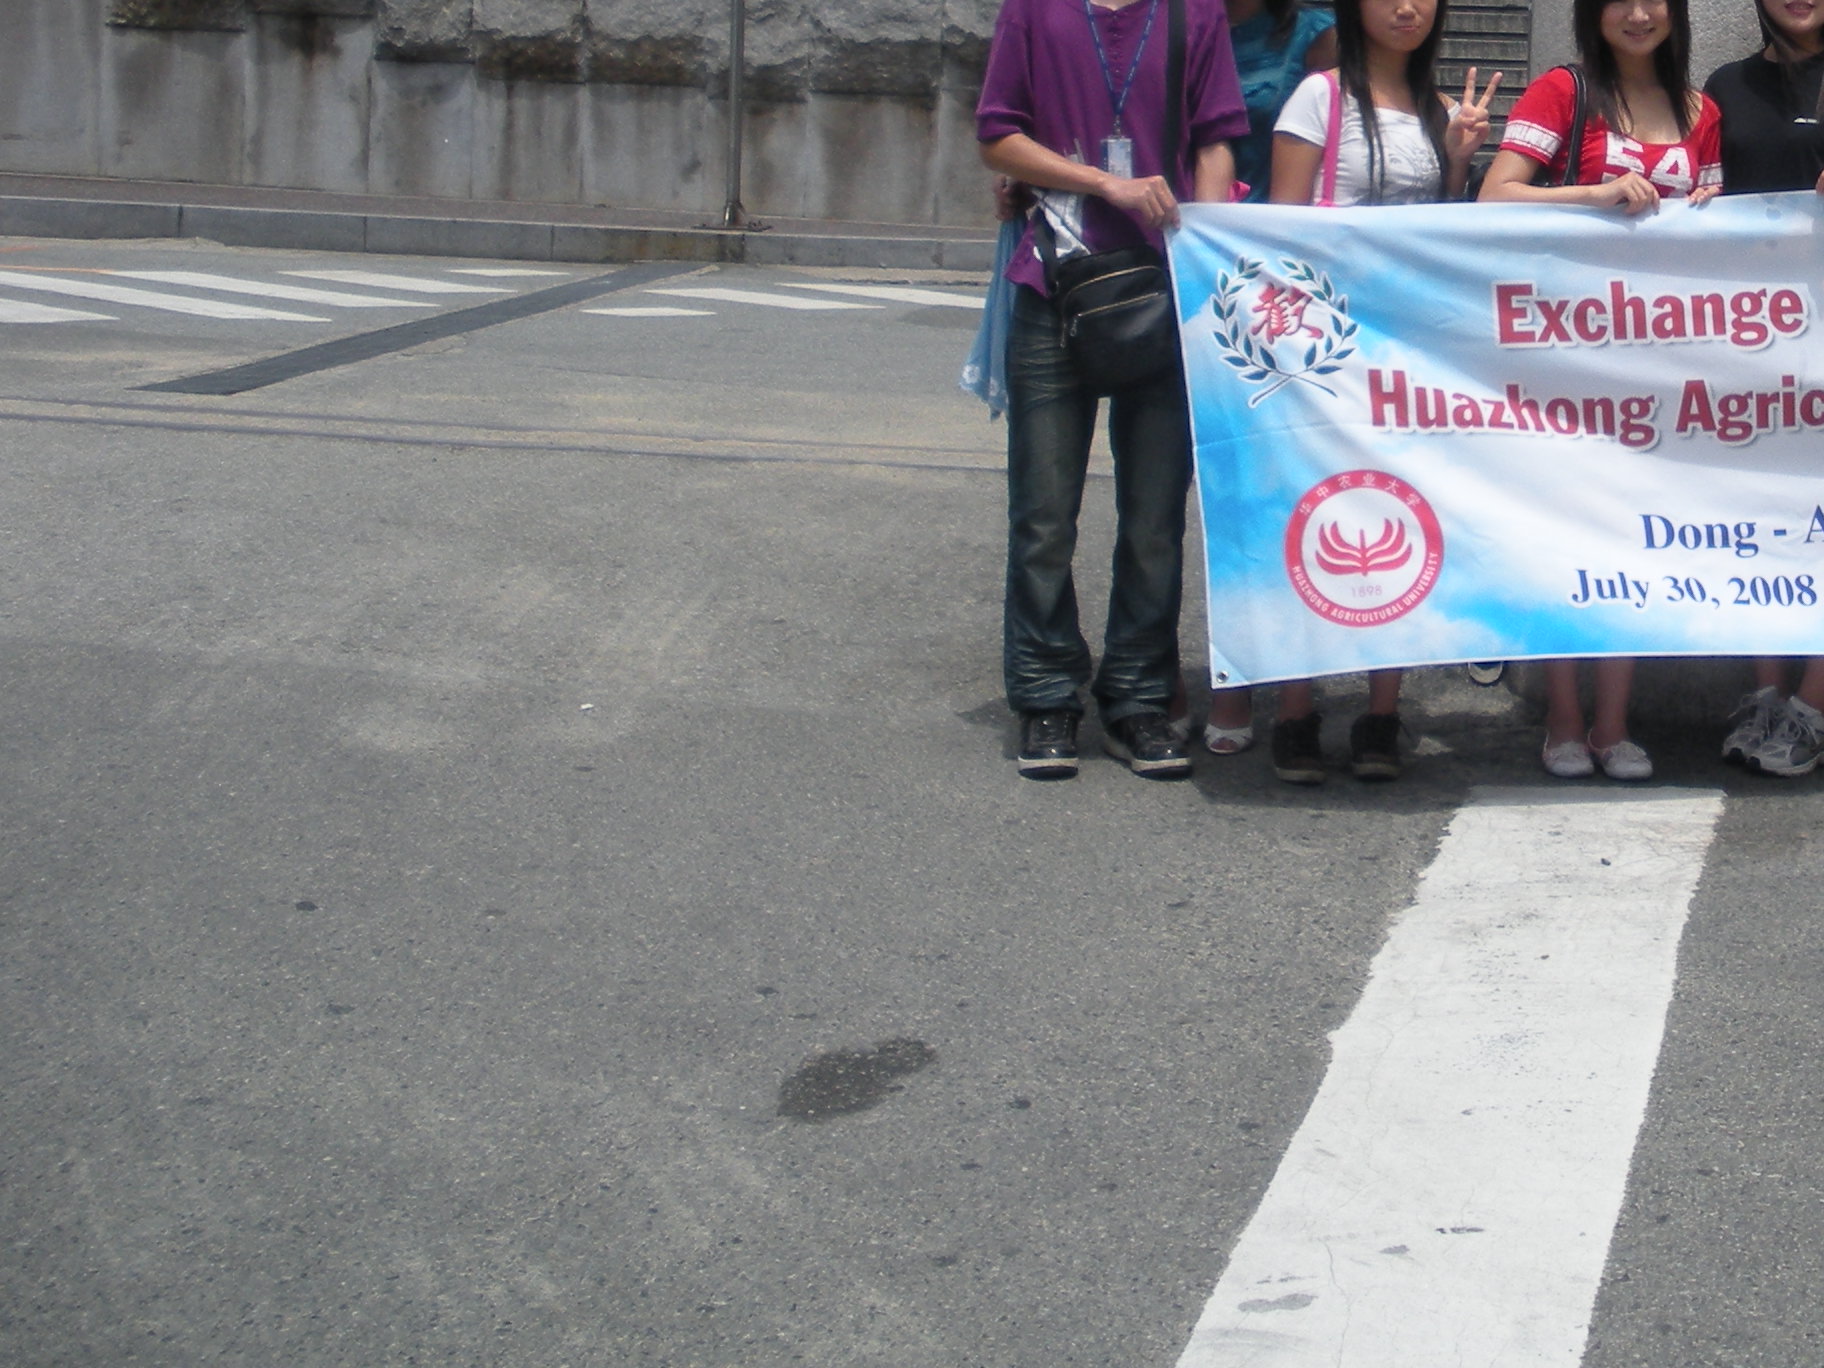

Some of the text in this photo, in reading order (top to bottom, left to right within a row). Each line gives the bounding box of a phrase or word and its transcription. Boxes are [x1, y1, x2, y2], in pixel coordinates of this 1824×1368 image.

[1601, 131, 1694, 198] 54
[1496, 280, 1804, 346] Exchange
[1368, 369, 1656, 448] Huazhong
[1639, 513, 1759, 558] Dong
[1291, 551, 1439, 624] HUAZHONG AGRICULTURAL UNIVERSITY
[1571, 568, 1650, 609] July
[1662, 575, 1721, 610] 30,
[1727, 574, 1818, 607] 2008
